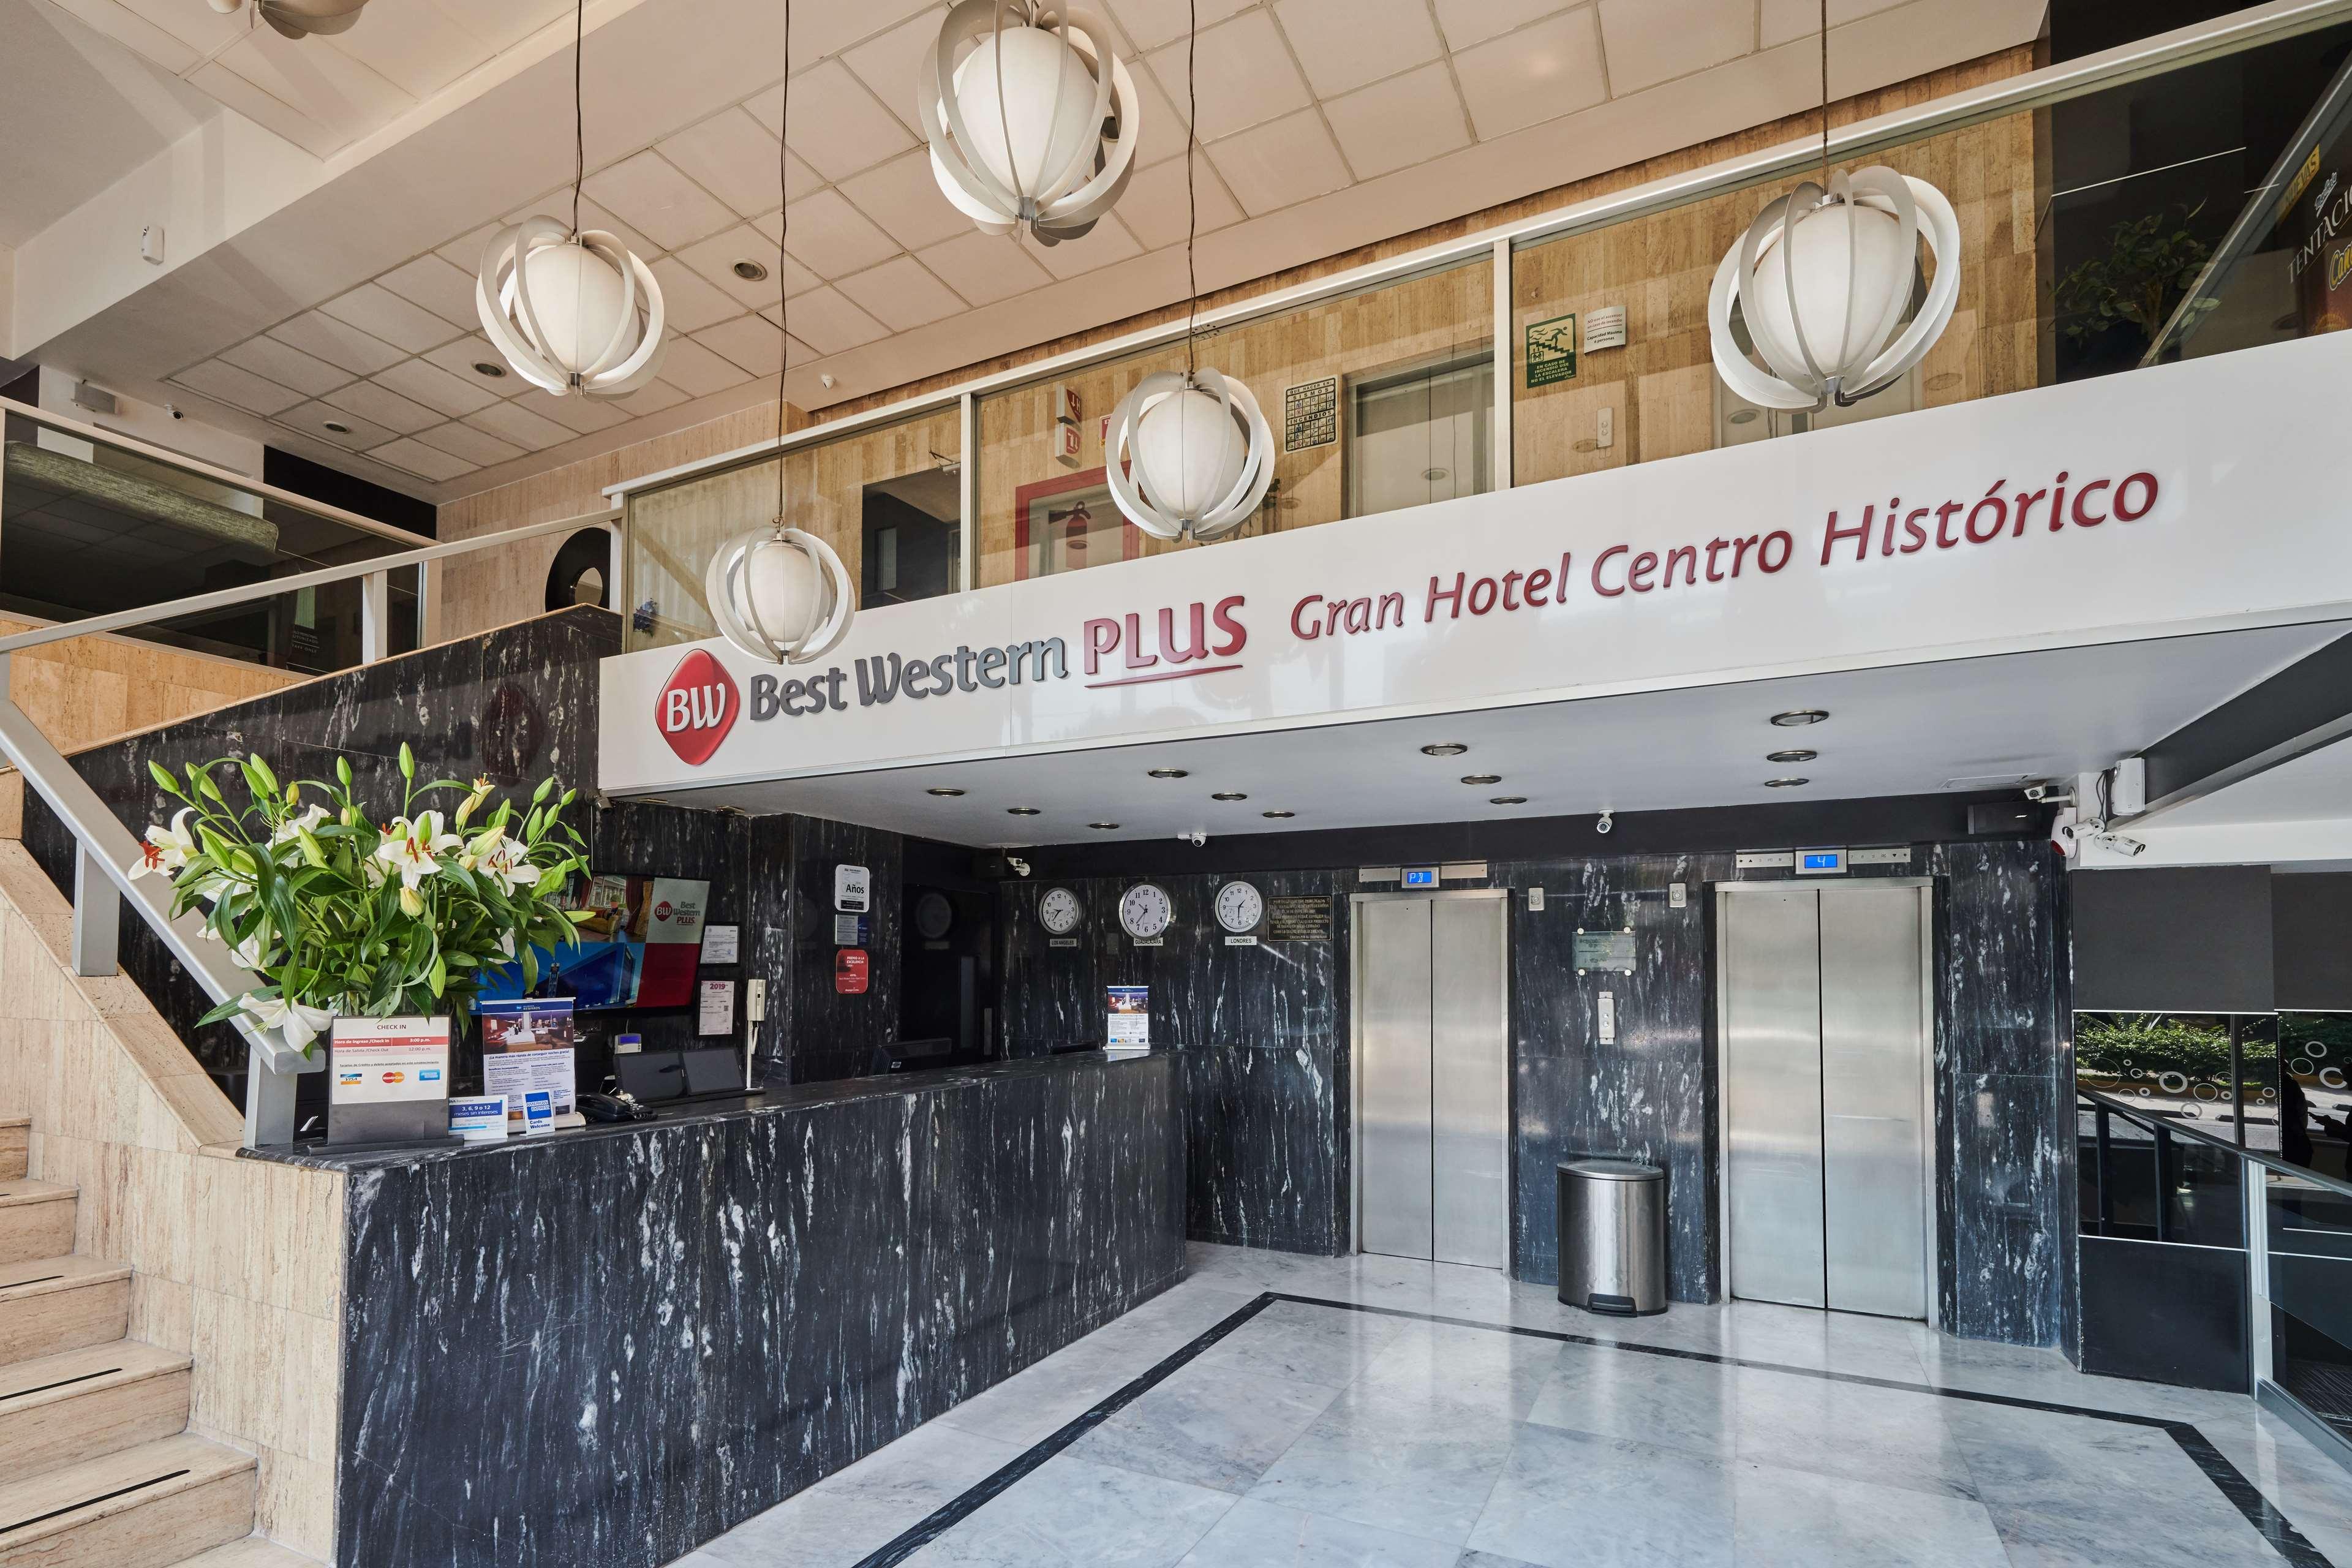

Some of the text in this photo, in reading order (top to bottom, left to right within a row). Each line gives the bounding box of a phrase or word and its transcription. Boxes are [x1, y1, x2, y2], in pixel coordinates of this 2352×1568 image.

[1587, 332, 1606, 341] Capacidad
[1542, 368, 1567, 376] ESCALERA
[1546, 370, 1572, 379] ELEVADOR
[1293, 388, 1329, 400] SISMOS
[1290, 411, 1332, 424] INCENDIOS
[1290, 470, 2159, 641] Gran Hotel Centro Histórico
[666, 597, 1247, 733] BW Best Western PLUS
[1817, 856, 1826, 867] 4
[846, 884, 864, 894] Años
